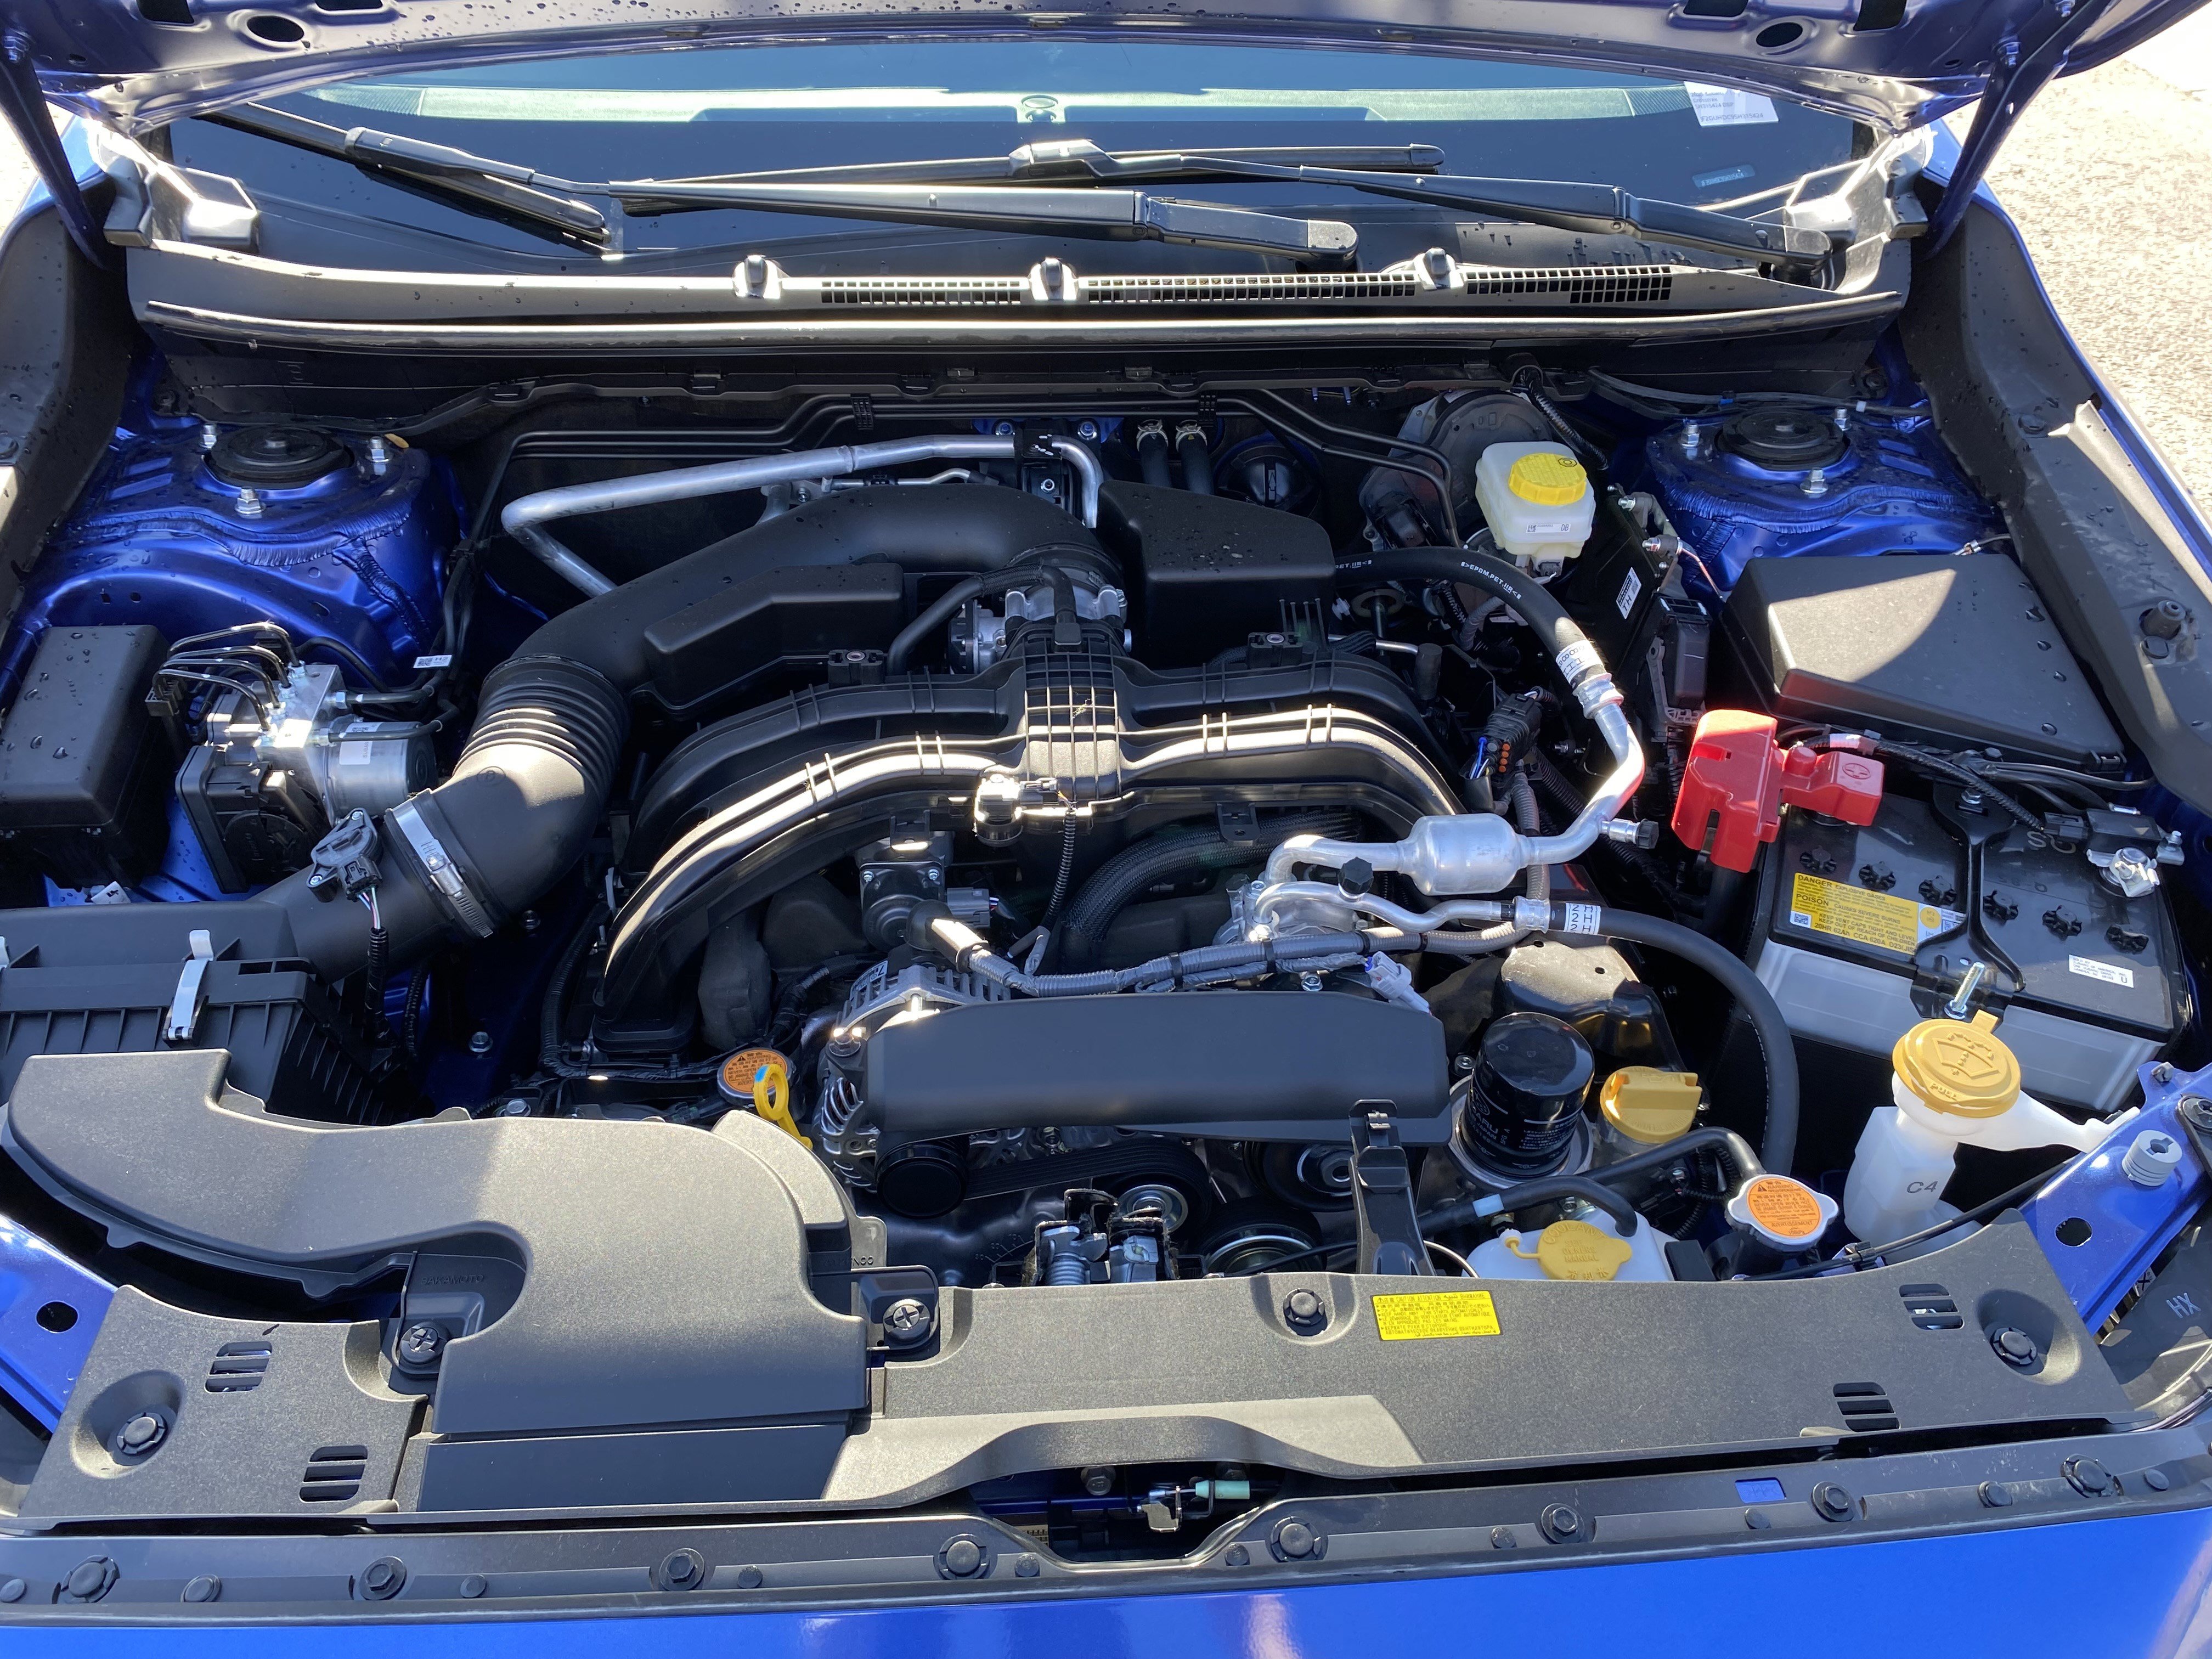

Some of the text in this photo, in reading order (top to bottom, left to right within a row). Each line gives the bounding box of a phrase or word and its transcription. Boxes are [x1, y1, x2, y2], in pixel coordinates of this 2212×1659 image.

[1798, 874, 1886, 901] DANGER EXPLOSIVE GASES
[1796, 893, 1900, 924] POISON CAUSES SEVERE BURNS
[1571, 913, 1592, 923] 2 H
[1814, 923, 1832, 932] 20HR
[1853, 933, 1868, 941] CCA
[1819, 917, 1833, 926] KEEP
[1857, 928, 1877, 936] REACH
[1887, 934, 1915, 946] CHILDREN
[1898, 933, 1916, 941] LEVEL
[1930, 1082, 1957, 1101] PULL
[1907, 1182, 1937, 1194] C4
[1544, 1222, 1607, 1245] COOLANT
[1564, 1254, 1600, 1262] MANUAL
